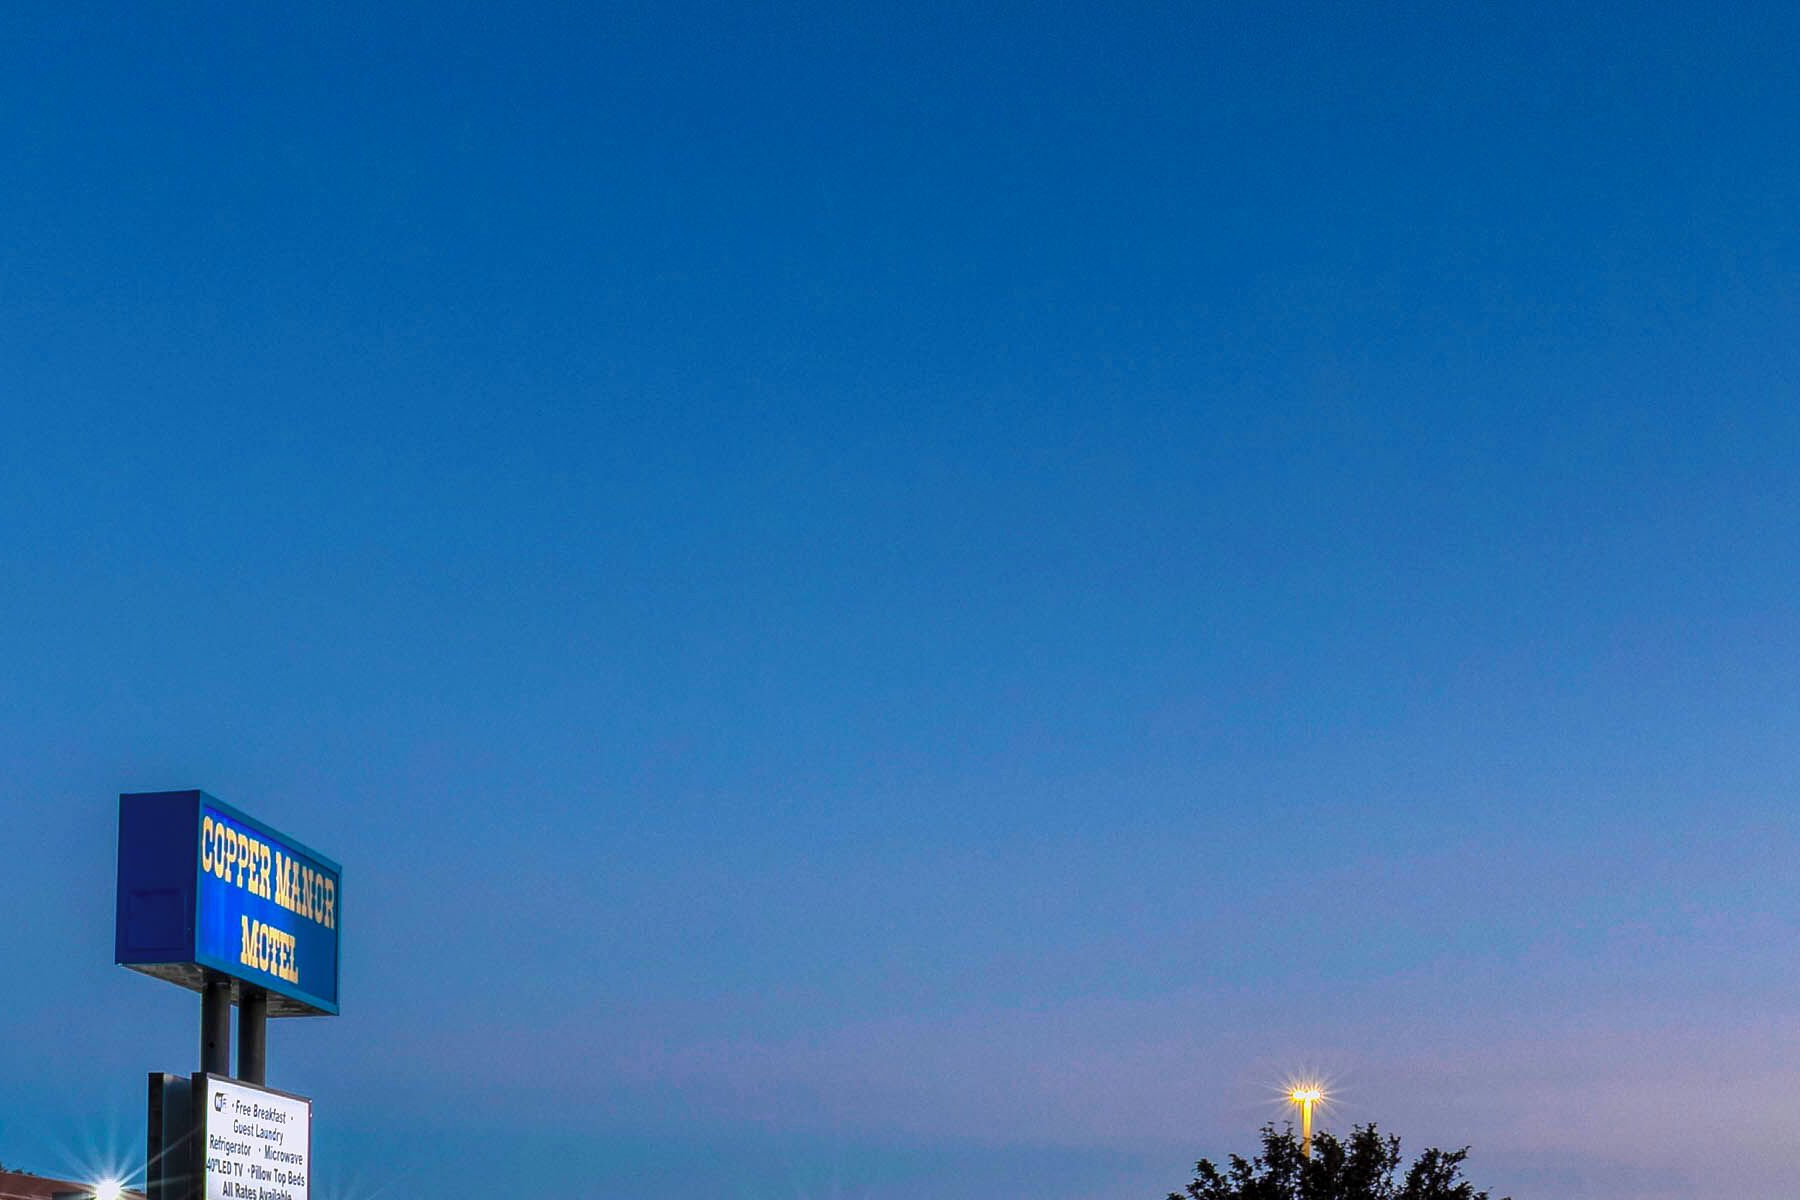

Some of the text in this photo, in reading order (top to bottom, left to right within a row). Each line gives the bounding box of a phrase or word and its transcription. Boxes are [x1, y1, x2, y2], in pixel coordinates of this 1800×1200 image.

[202, 816, 335, 929] COPPER MANOR
[240, 915, 298, 984] MOTEL
[235, 1100, 251, 1117] Free
[253, 1104, 286, 1124] Breakfast
[233, 1119, 284, 1146] Guest Laundry
[210, 1134, 303, 1165] Refrigerator Microwave
[234, 1162, 243, 1177] TV
[251, 1164, 272, 1181] Pillow
[274, 1168, 286, 1188] Top
[288, 1171, 305, 1187] Beds
[222, 1181, 234, 1197] All
[235, 1183, 257, 1200] Rates
